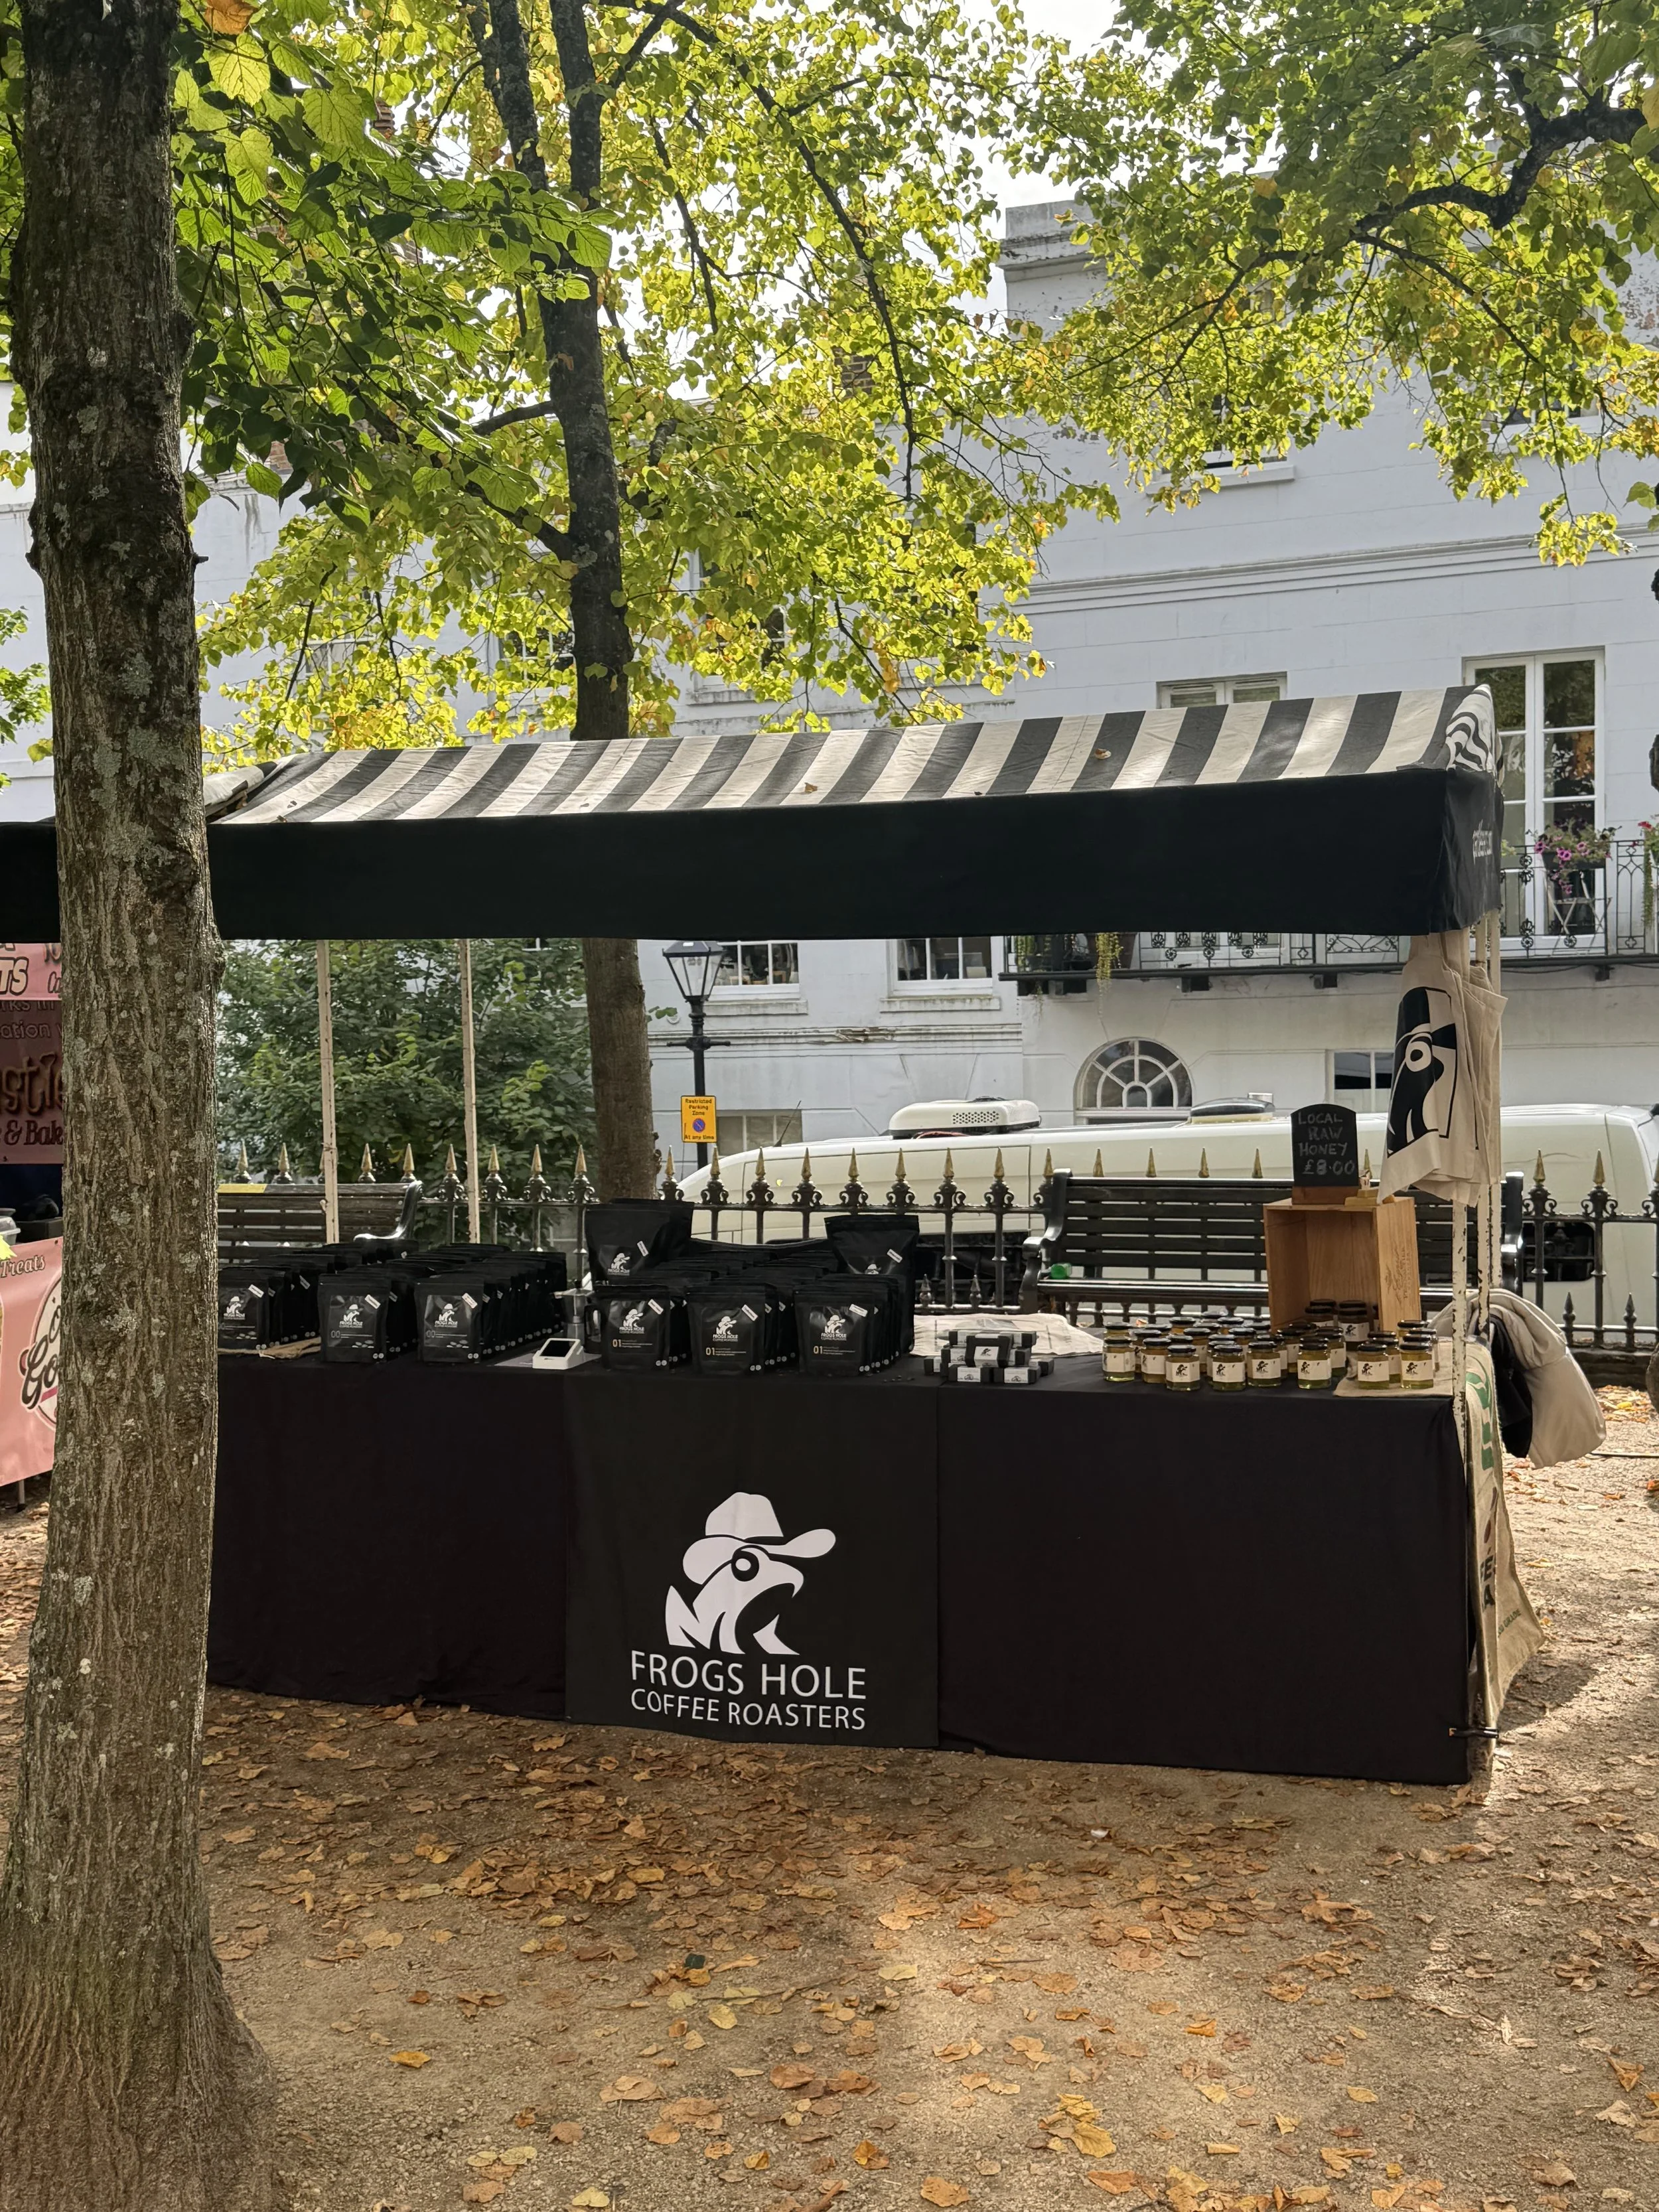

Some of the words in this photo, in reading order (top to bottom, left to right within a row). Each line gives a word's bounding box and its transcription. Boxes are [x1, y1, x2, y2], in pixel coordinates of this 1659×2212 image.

[1298, 1112, 1343, 1125] LOCAL
[4, 1120, 22, 1145] &
[1309, 1126, 1343, 1141] RAW
[1298, 1142, 1348, 1156] HONEY
[813, 1345, 823, 1354] 01
[632, 1650, 744, 1695] FROGS
[762, 1664, 866, 1700] HOLE
[631, 1689, 719, 1722] COFFEE
[729, 1702, 865, 1731] ROASTERS
